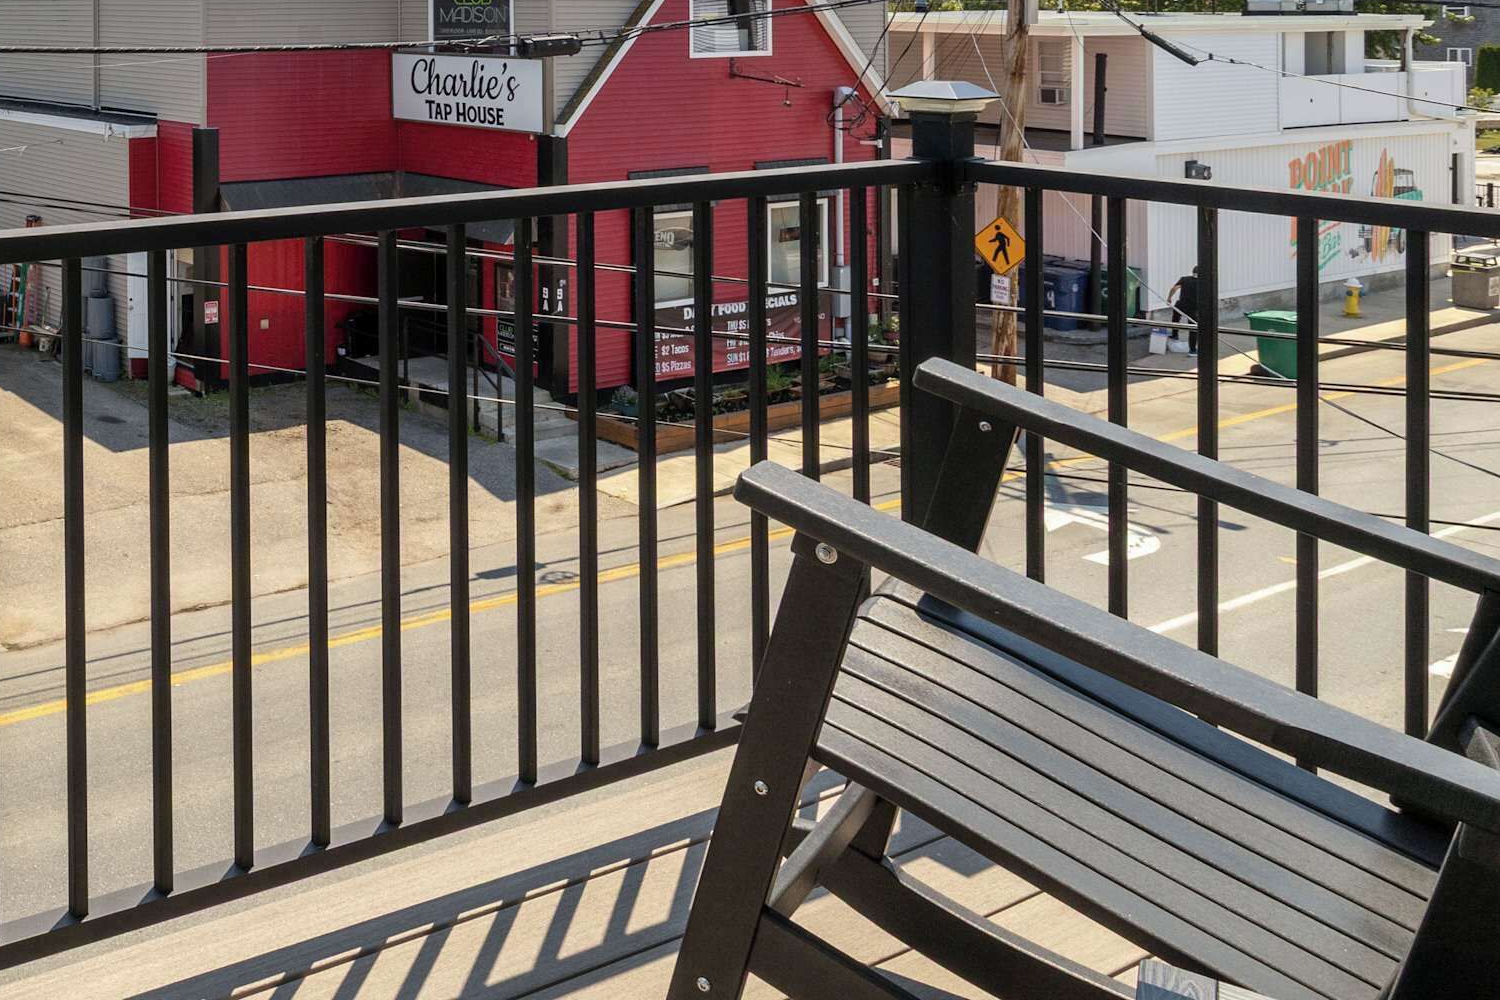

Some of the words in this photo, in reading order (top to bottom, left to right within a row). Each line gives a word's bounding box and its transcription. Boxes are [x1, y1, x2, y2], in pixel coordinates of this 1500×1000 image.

[439, 6, 507, 24] MADISON
[411, 58, 520, 102] Charlie's
[425, 99, 453, 121] TAP
[456, 102, 505, 126] HOUSE
[1288, 139, 1353, 191] POINT
[717, 302, 746, 316] FOOD
[671, 344, 689, 355] Tacos
[671, 361, 692, 371] Pizzas
